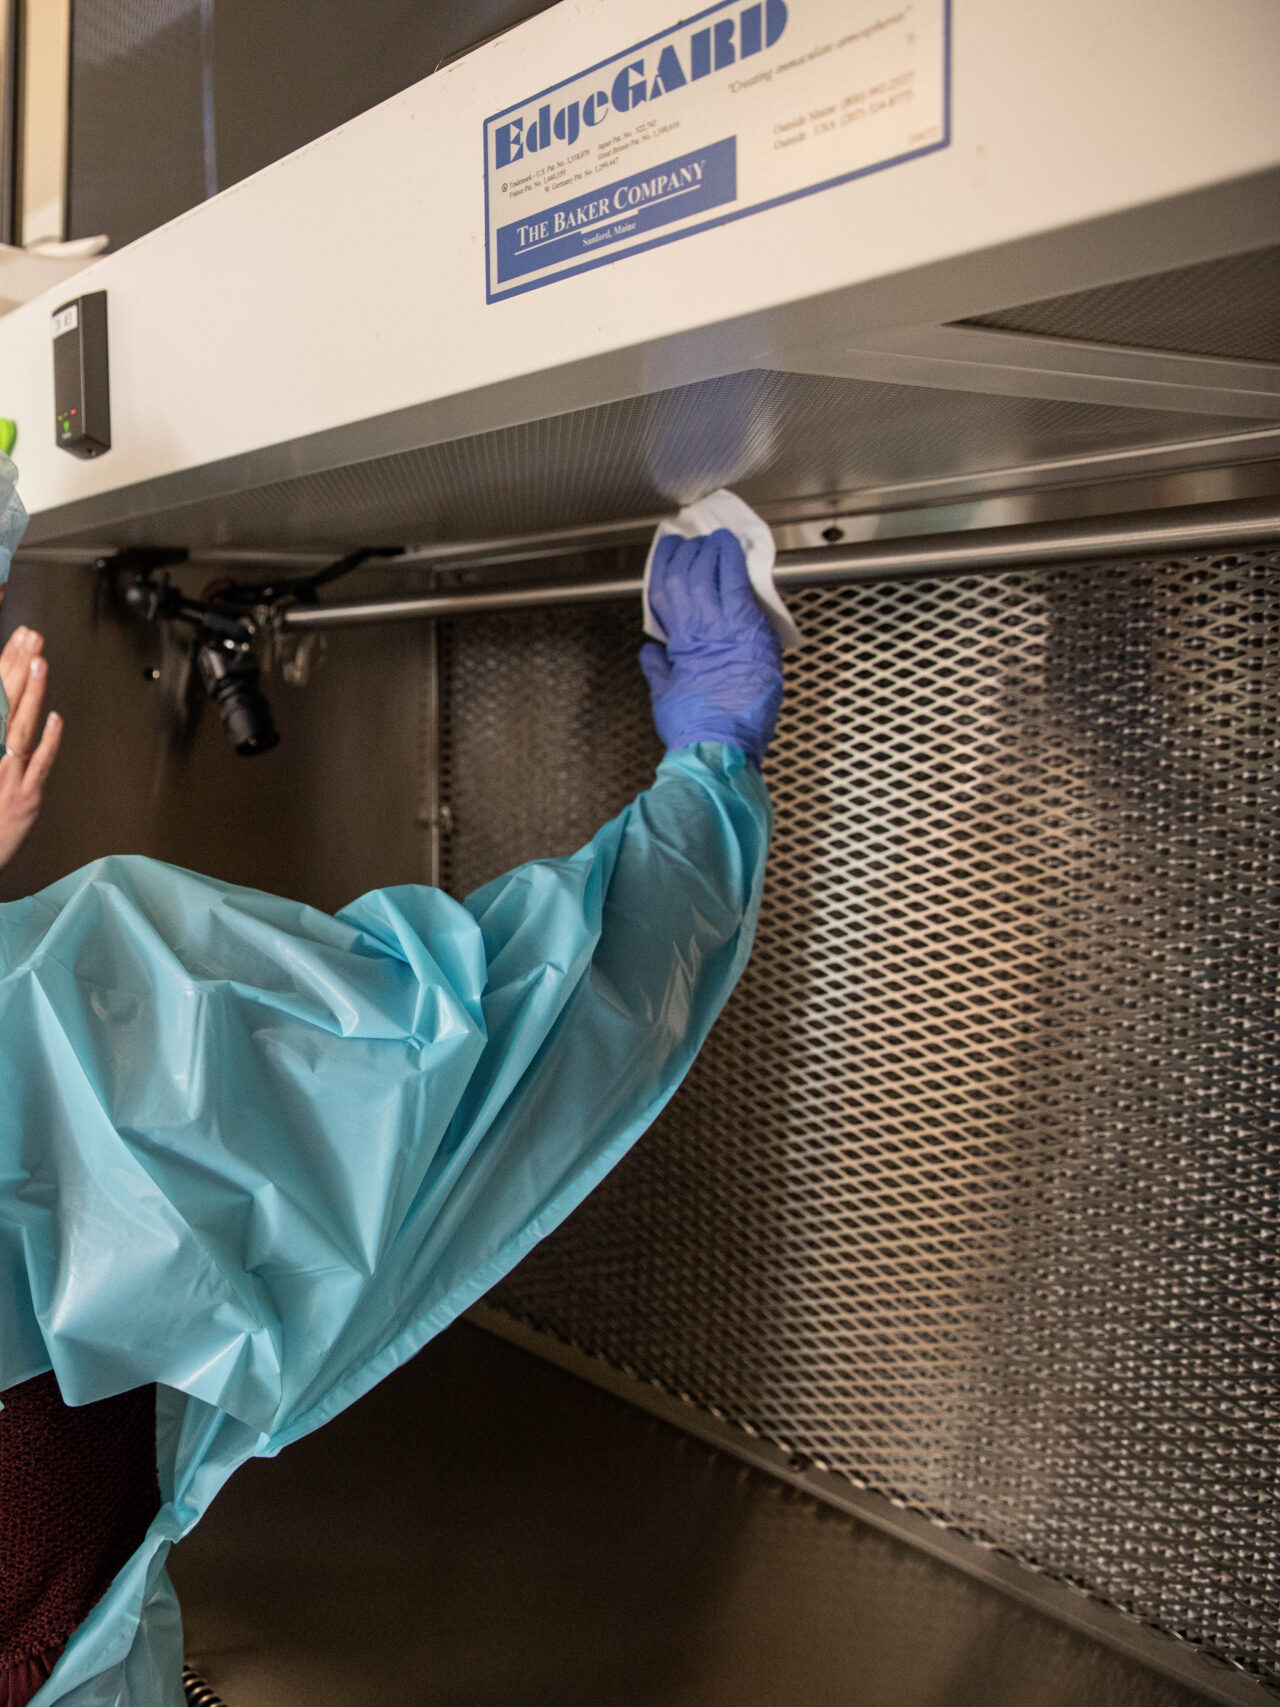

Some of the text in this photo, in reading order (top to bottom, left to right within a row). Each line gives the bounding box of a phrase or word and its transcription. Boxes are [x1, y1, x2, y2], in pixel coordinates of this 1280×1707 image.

[494, 0, 788, 169] EdgeGARD
[516, 160, 706, 247] THE BAKER COMPANY
[613, 221, 637, 237] Maine
